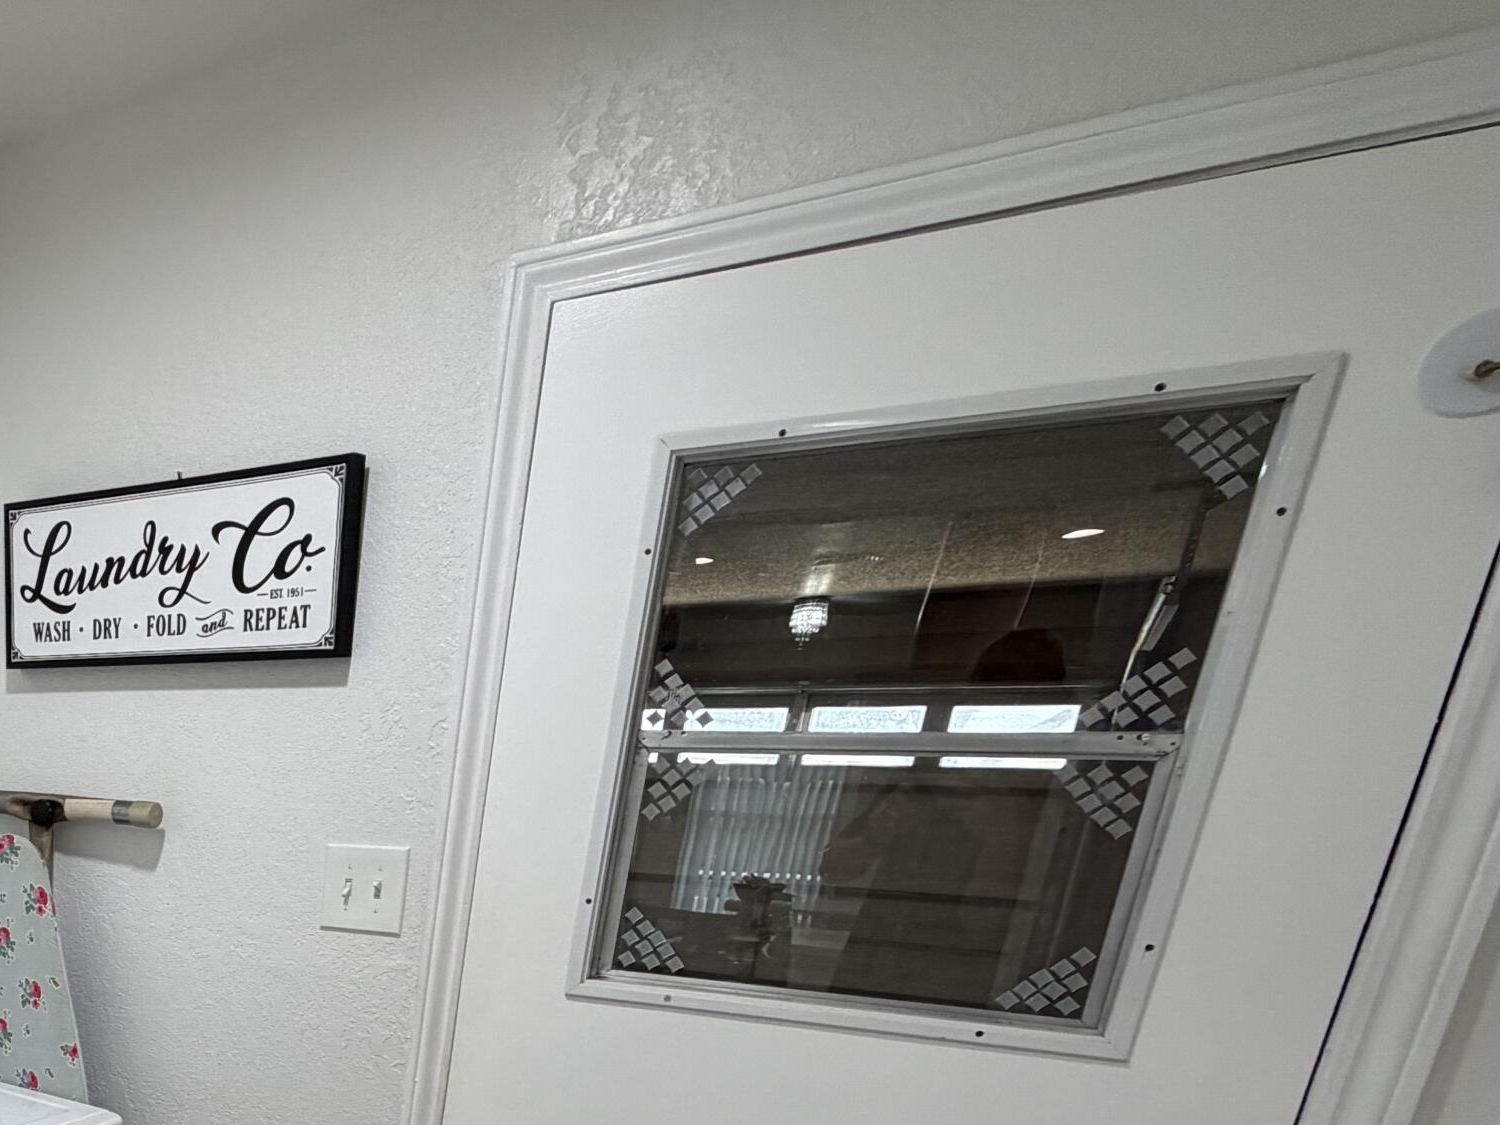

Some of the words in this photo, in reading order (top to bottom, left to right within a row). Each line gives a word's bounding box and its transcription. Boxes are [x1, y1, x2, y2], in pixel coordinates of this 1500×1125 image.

[20, 520, 211, 614] Laundry
[211, 497, 326, 595] Co.
[287, 586, 304, 598] 1951
[32, 620, 71, 643] WASH
[92, 617, 122, 640] DRY
[146, 613, 187, 637] FOLD
[201, 611, 229, 633] and
[242, 603, 311, 632] REPEAT
